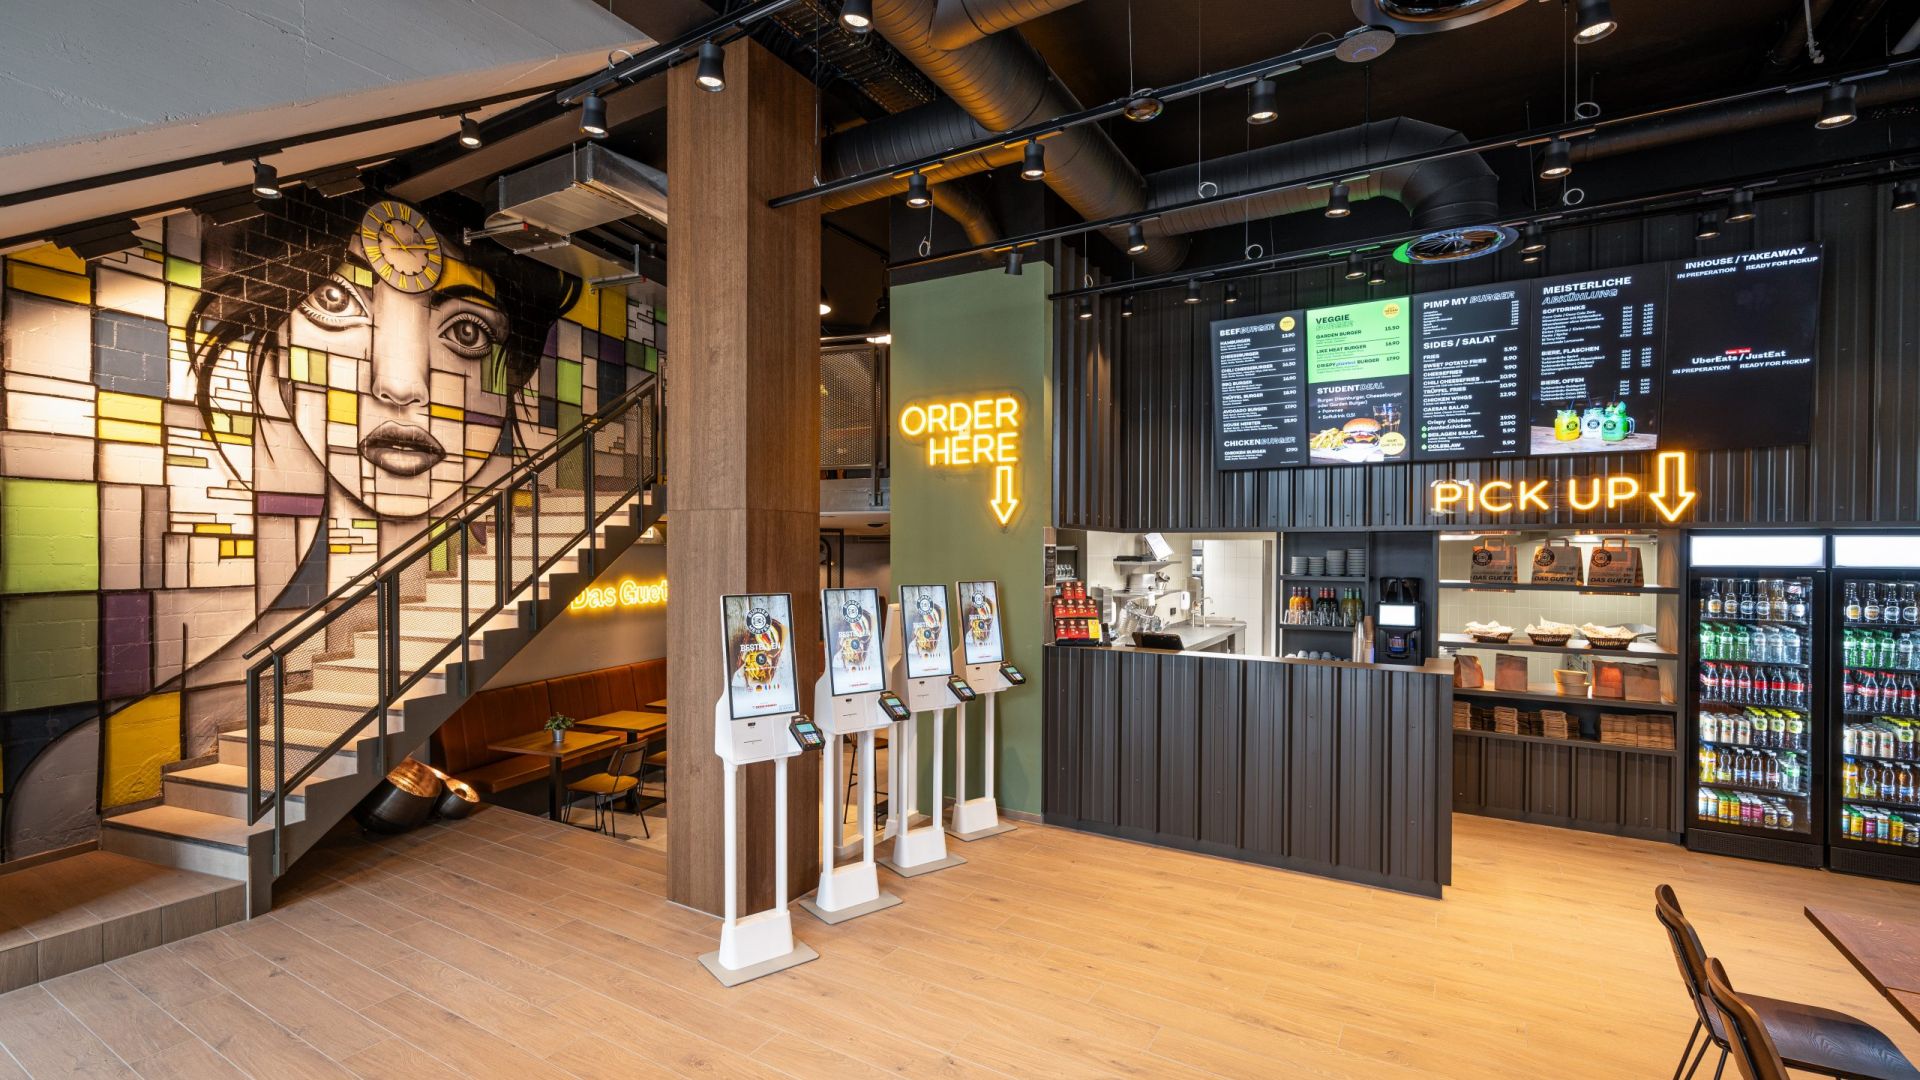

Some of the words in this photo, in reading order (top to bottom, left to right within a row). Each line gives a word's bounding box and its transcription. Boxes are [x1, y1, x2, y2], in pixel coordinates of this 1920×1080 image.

[1685, 256, 1733, 269] INHOUSE
[1735, 255, 1741, 264] /
[1741, 247, 1805, 262] TAKEAWAY
[1746, 262, 1770, 270] READY
[1788, 256, 1818, 265] PICKUP
[1686, 267, 1736, 278] PREPERATION
[1543, 276, 1632, 295] MEISTERLICHE
[1423, 300, 1450, 309] PIMP
[1452, 297, 1468, 306] MY
[1469, 291, 1515, 304] BURGER
[1542, 305, 1586, 314] SOFTDRINKS
[1316, 314, 1350, 325] VEGGIE
[1220, 323, 1275, 337] BEEFBURGER
[1220, 338, 1251, 346] HAMBURGER
[1423, 340, 1454, 349] SIDES
[1462, 335, 1496, 345] SALAT
[1221, 351, 1259, 359] CHEESEBURGER
[1563, 346, 1599, 354] FLASCHEN
[1692, 355, 1738, 365] UberEats
[1745, 350, 1786, 360] JustEat
[1781, 358, 1810, 366] PICKUP
[1681, 365, 1730, 374] PREPERATION
[901, 397, 1019, 436] ORDER
[929, 432, 1018, 466] HERE
[1433, 479, 1550, 513] PICK
[1568, 476, 1640, 511] UP
